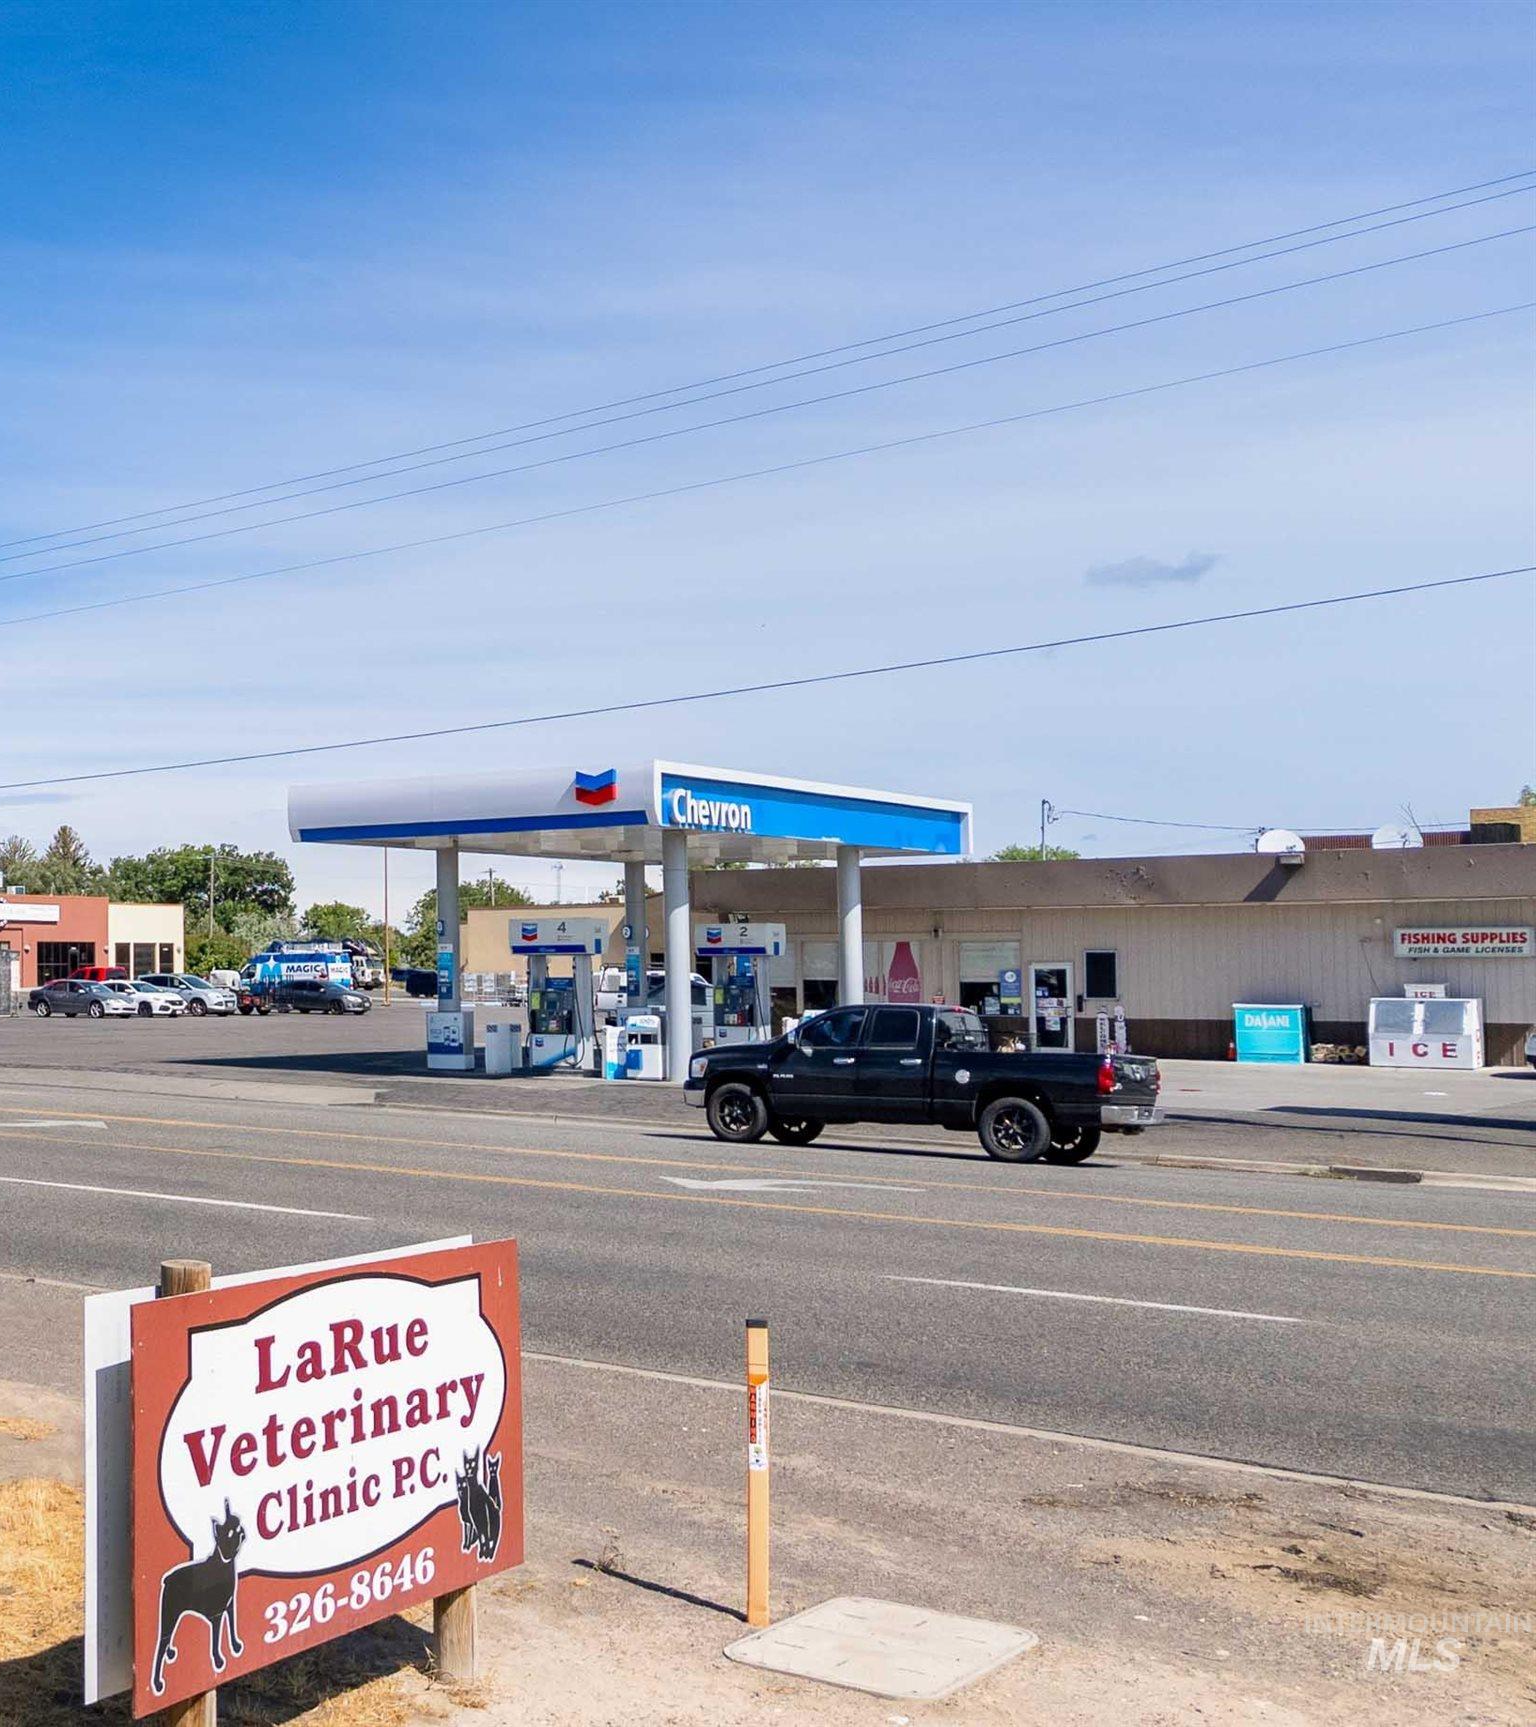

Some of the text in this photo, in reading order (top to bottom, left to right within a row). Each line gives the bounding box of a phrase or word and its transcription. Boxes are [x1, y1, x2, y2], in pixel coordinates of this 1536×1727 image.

[673, 787, 752, 830] Chevron
[557, 921, 567, 934] 4
[739, 926, 749, 937] 2
[1400, 931, 1528, 945] FISHING SUPPLIES
[1408, 946, 1430, 954] FISH
[1442, 946, 1471, 954] GAME
[1475, 946, 1524, 954] LICENSES
[285, 964, 321, 974] MAGIC
[1245, 1012, 1290, 1030] DASANI
[1388, 1042, 1458, 1058] ICE
[254, 1318, 429, 1394] LaRue
[183, 1373, 485, 1488] Veterinary
[256, 1447, 448, 1540] Clinic P.C.
[263, 1547, 435, 1644] 326-8646
